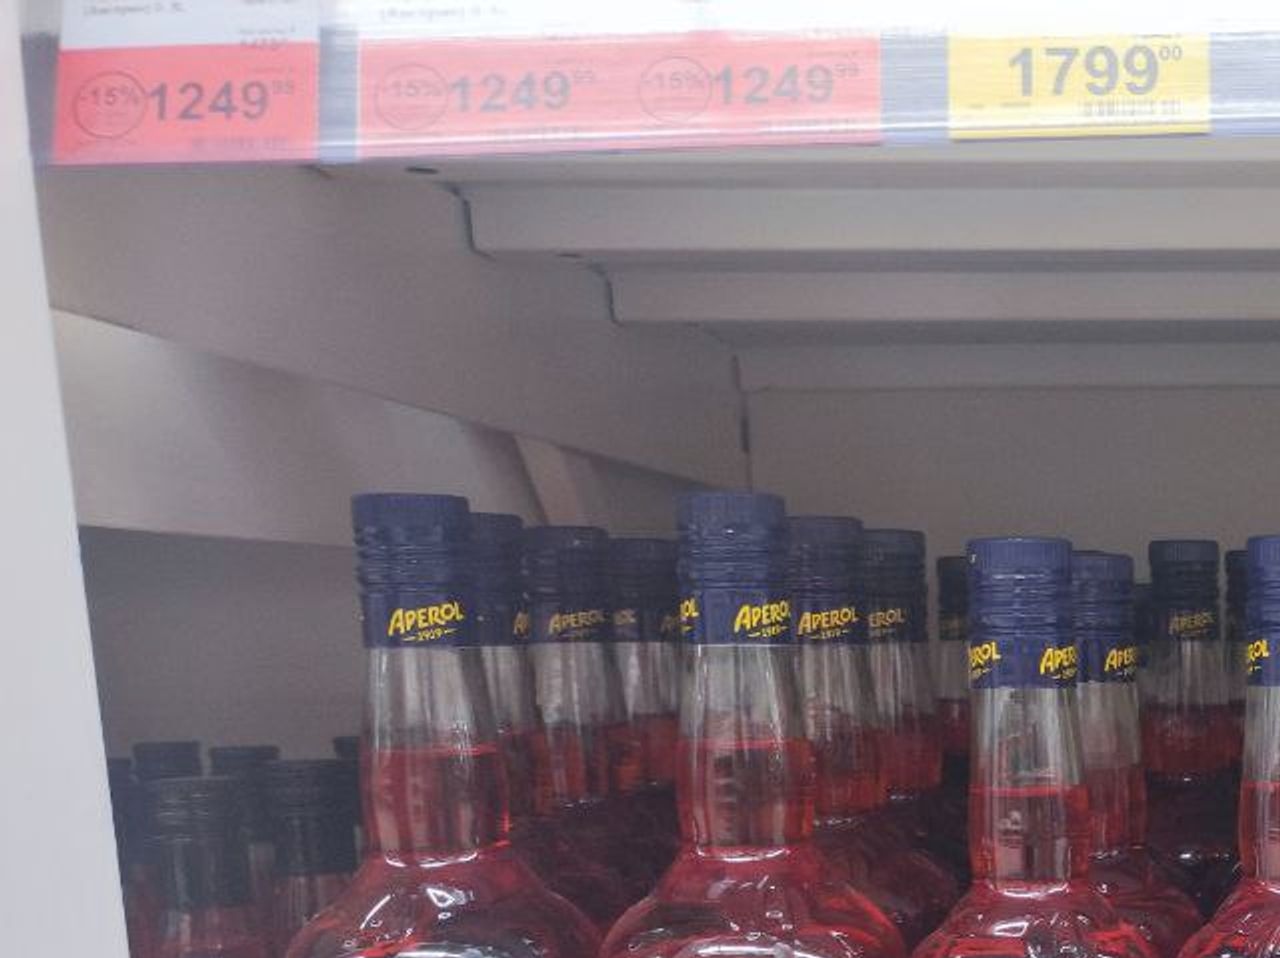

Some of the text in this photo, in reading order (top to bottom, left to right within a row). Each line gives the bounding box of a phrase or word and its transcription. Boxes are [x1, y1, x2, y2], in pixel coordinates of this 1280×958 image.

[451, 70, 572, 113] 1249
[713, 63, 834, 105] 1249
[1008, 44, 1159, 97] 1799
[150, 80, 270, 122] 1249
[387, 601, 465, 637] APEROL
[798, 606, 859, 635] APEROL
